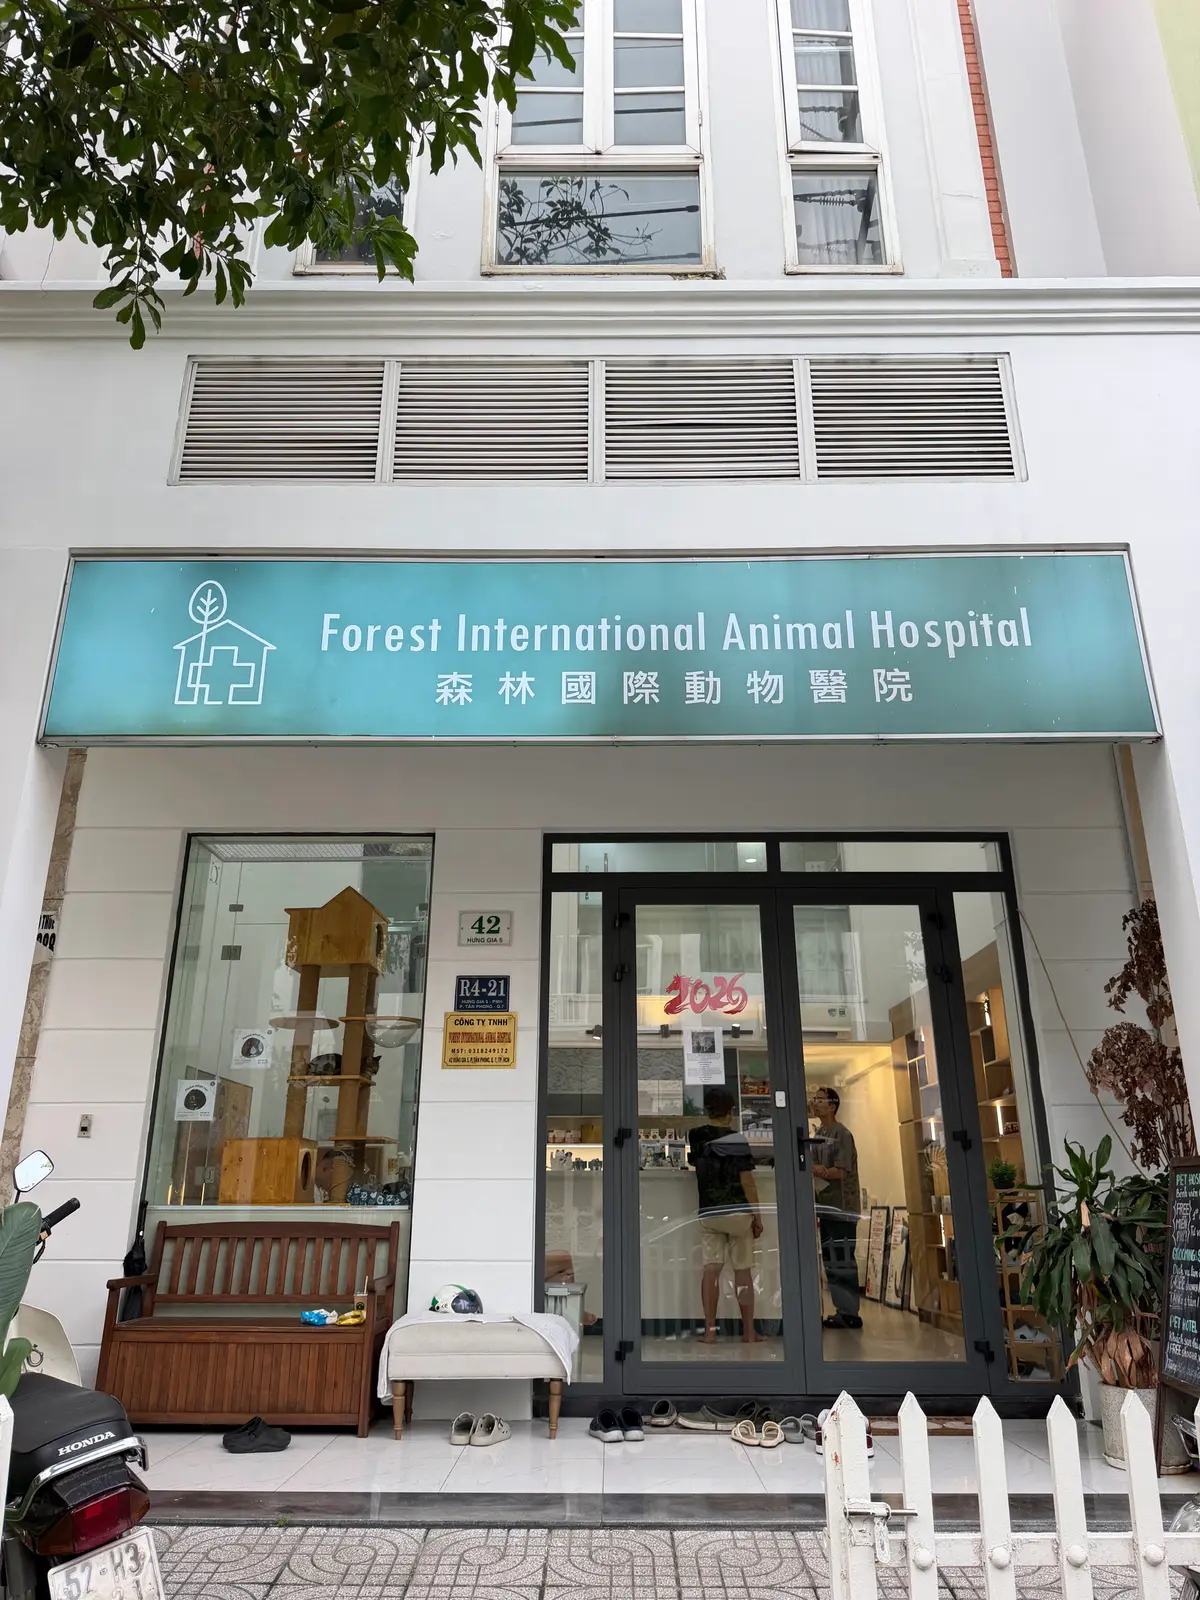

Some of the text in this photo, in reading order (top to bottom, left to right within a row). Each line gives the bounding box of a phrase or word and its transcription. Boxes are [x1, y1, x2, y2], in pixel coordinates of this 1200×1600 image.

[321, 607, 1032, 658] Forest International Animal Hospital
[435, 668, 914, 706] 森林國際動物醫院
[470, 915, 501, 934] 42
[459, 979, 506, 997] R4-21
[664, 973, 748, 1015] 2026
[454, 1017, 508, 1026] CÔNG TY TNHH
[1176, 1173, 1188, 1186] PET
[1176, 1202, 1190, 1216] FREE
[1170, 1314, 1198, 1333] PET HOTEL
[58, 1430, 116, 1457] HONDA
